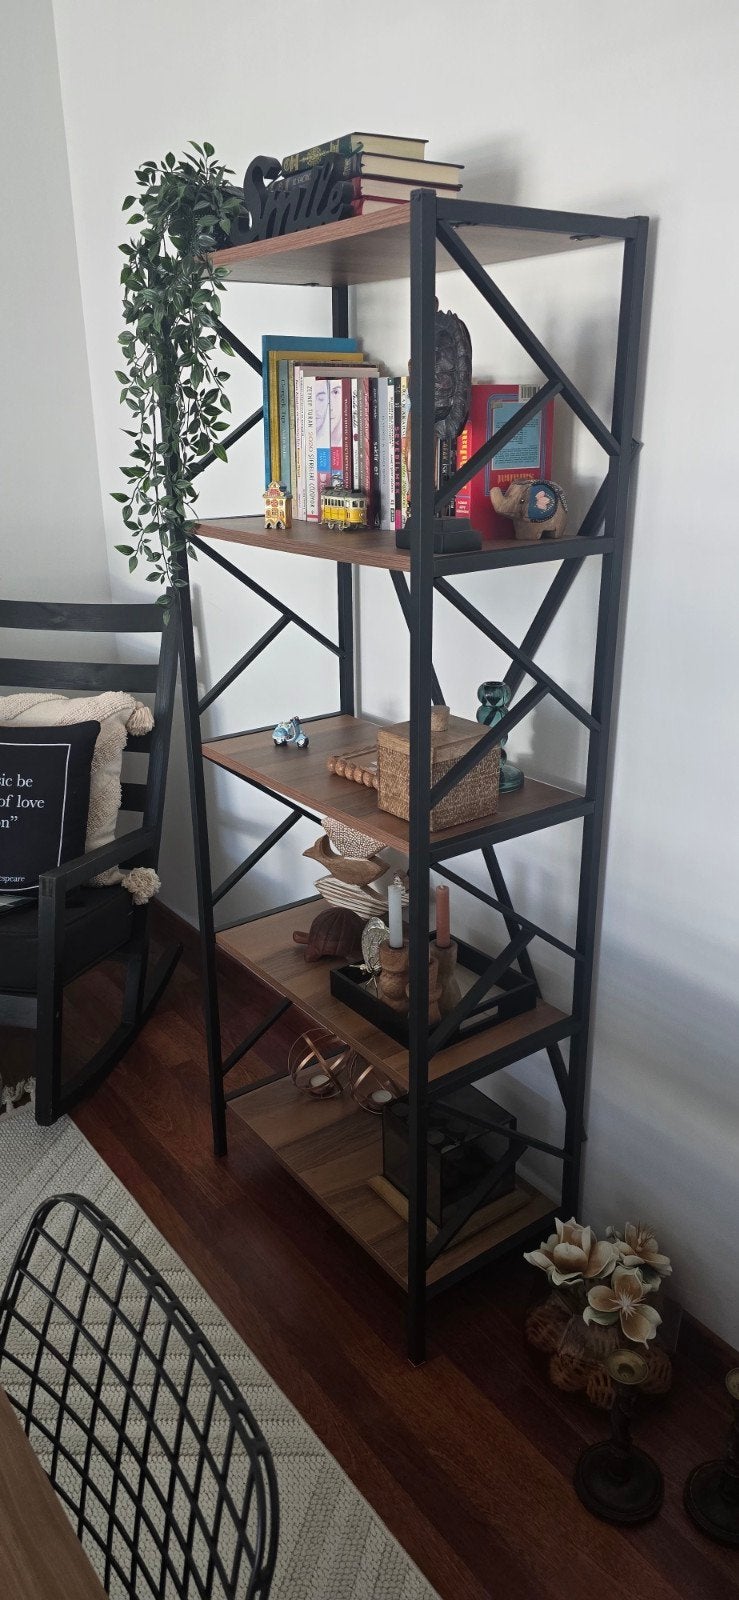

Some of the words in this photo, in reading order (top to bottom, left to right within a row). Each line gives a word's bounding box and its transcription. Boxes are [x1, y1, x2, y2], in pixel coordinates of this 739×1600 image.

[17, 773, 33, 788] be
[0, 794, 14, 808] of
[17, 794, 45, 808] love
